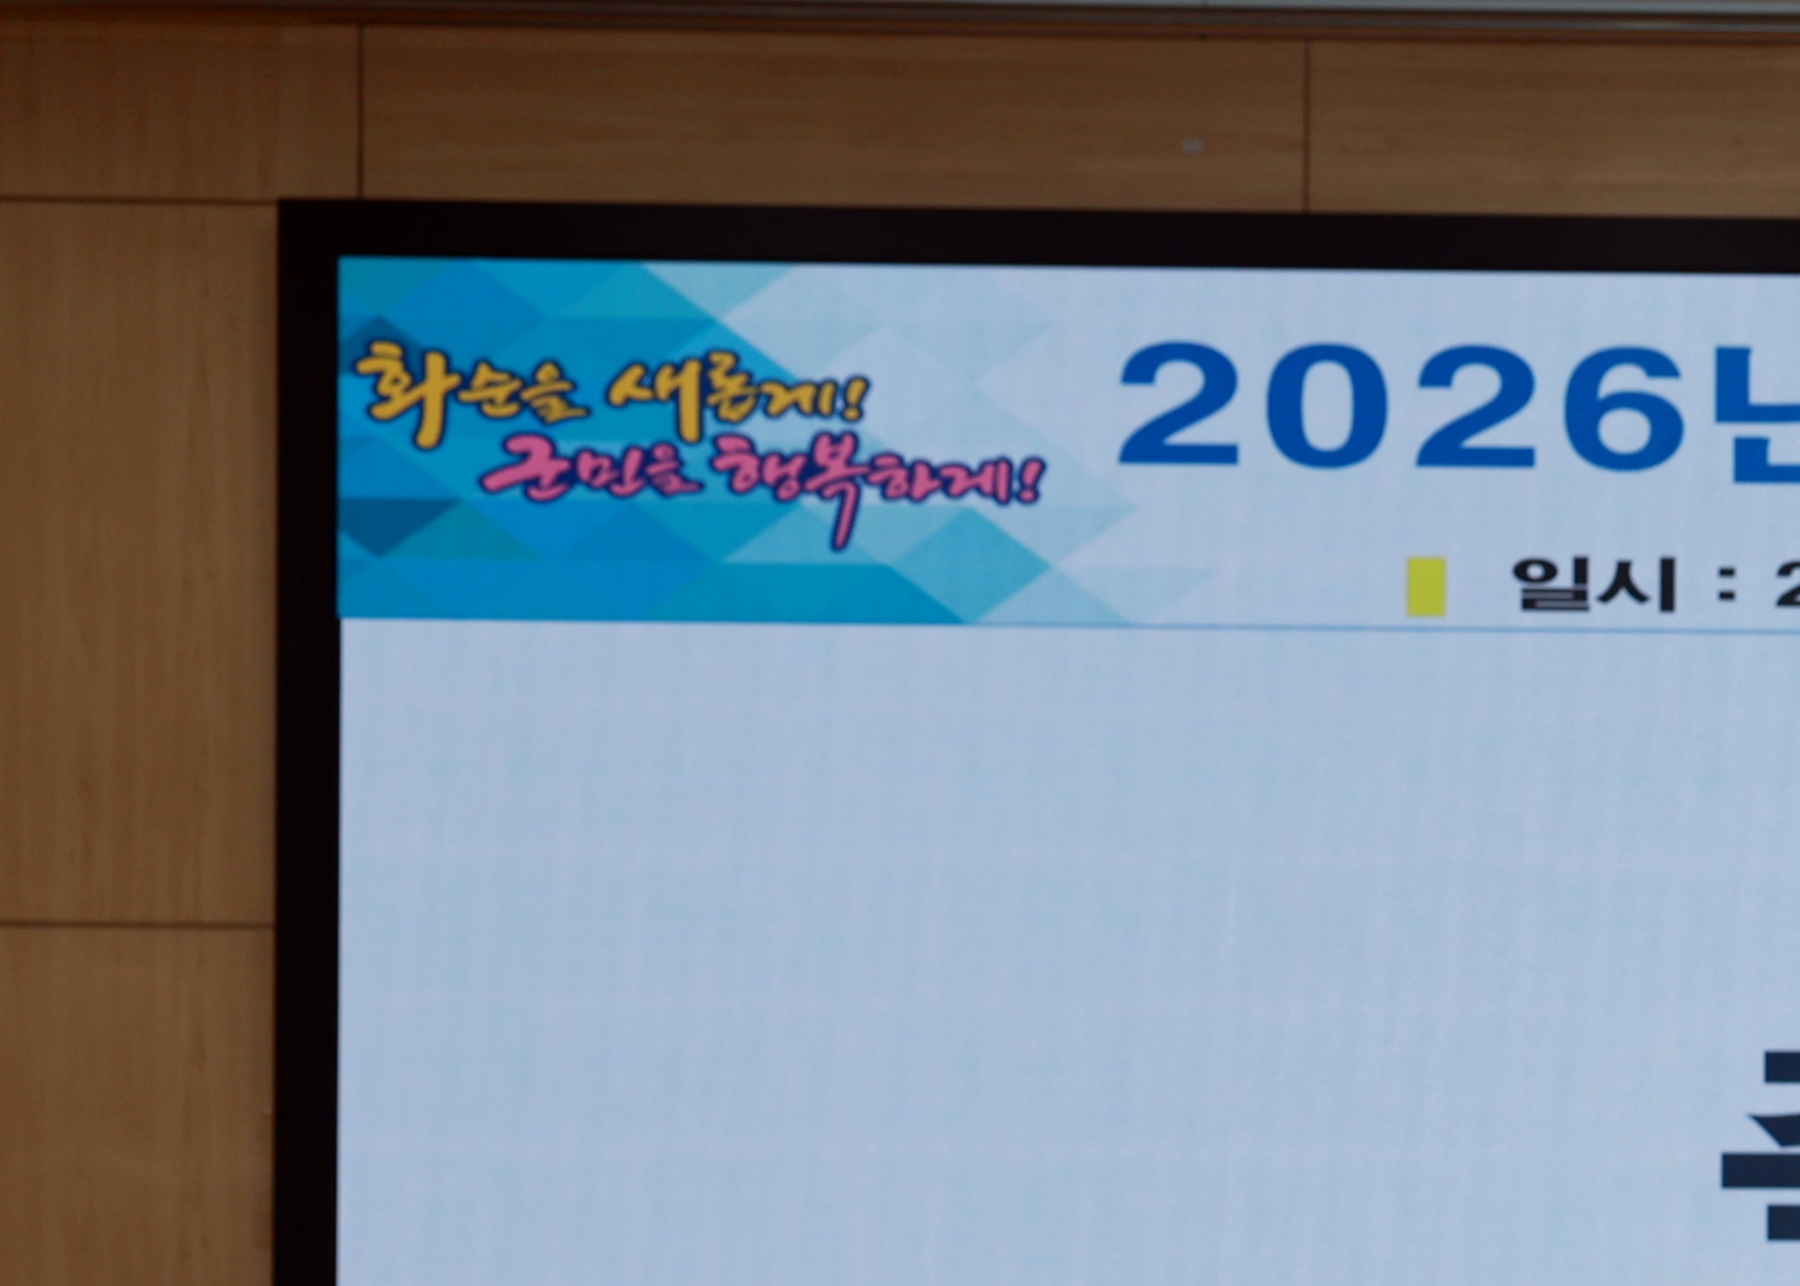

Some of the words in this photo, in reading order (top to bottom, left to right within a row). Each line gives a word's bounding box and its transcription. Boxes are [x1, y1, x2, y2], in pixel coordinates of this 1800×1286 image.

[356, 341, 586, 448] 화순을
[608, 350, 868, 444] 새롭게!
[481, 433, 702, 501] 군민을
[711, 432, 1045, 550] 행복하게!
[1511, 555, 1677, 614] 일시
[1717, 566, 1736, 602] :
